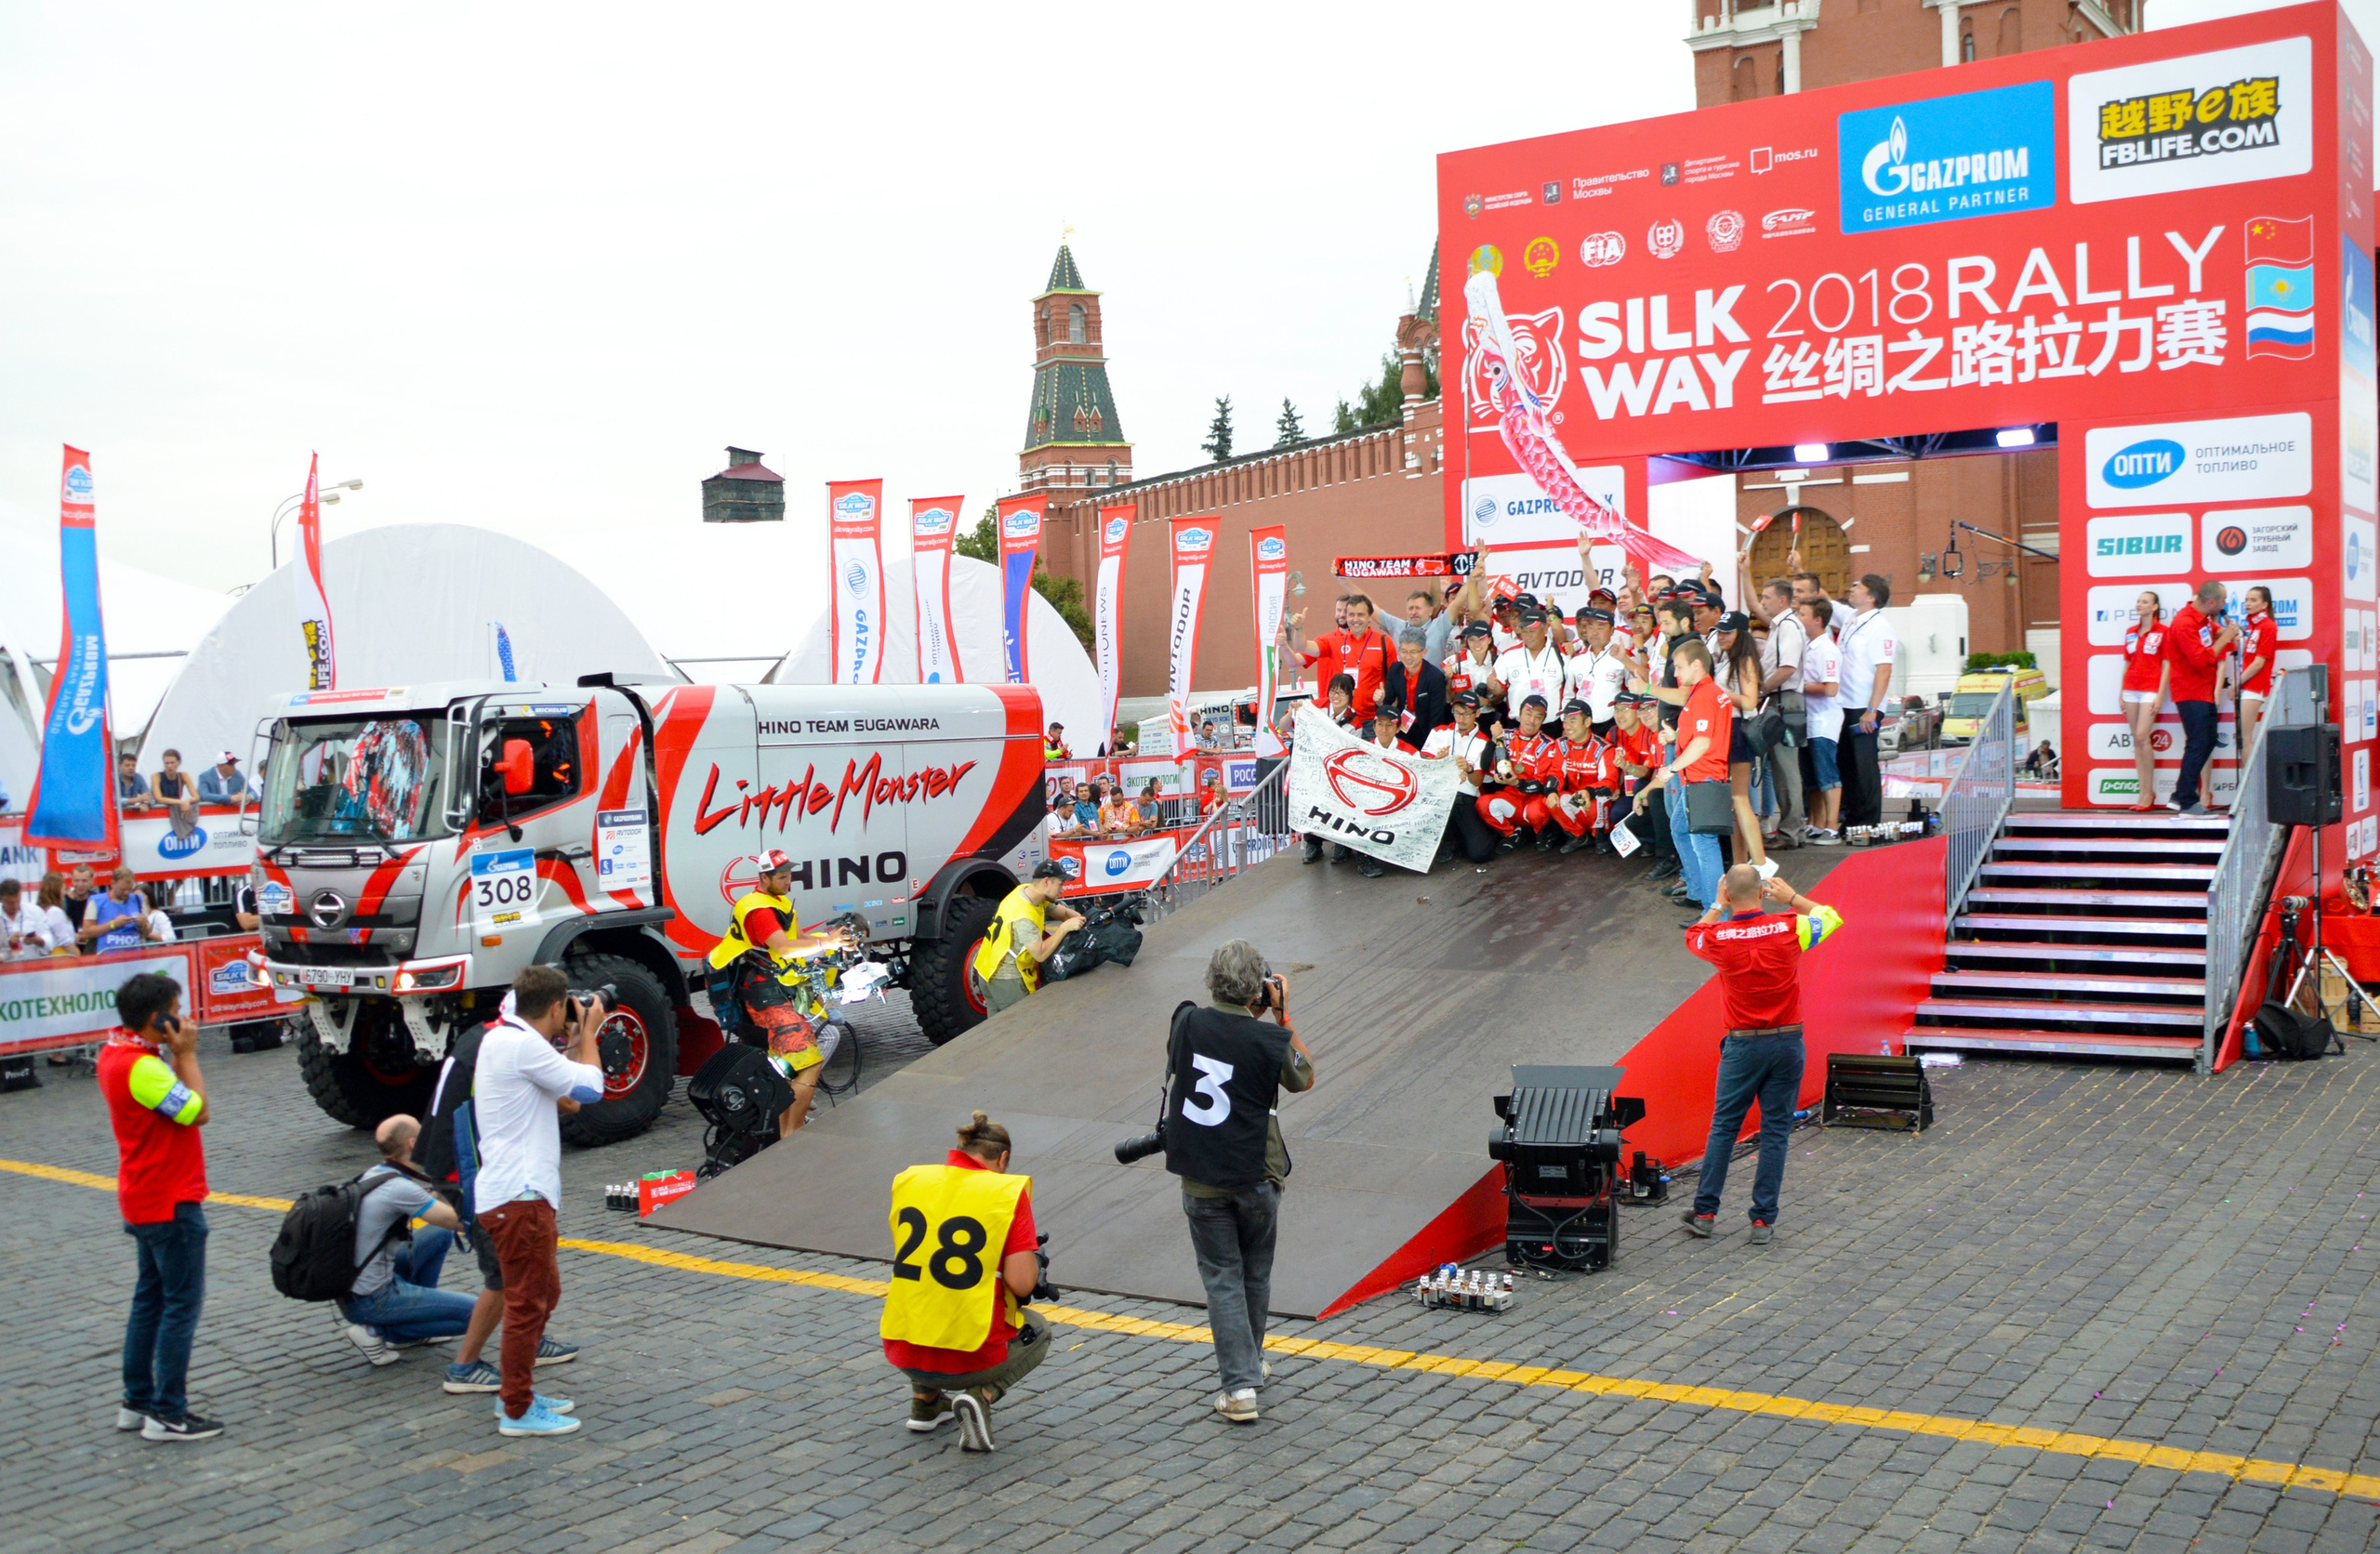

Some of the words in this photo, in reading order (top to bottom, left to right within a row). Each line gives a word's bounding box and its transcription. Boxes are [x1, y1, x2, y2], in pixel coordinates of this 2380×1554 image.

[2099, 77, 2278, 140] 越野e族
[2102, 121, 2277, 167] FBLIFE.COM
[1775, 149, 1818, 163] mos.ru
[1573, 168, 1650, 190] Правительство
[1911, 147, 2029, 193] GAZPROM
[1573, 187, 1612, 200] Москвы
[1863, 200, 1941, 223] GENERAL
[1949, 187, 2030, 211] PARTNER
[1579, 283, 1752, 360] SILK
[1766, 262, 1934, 339] 2018
[1948, 225, 2226, 320] RALLY
[1762, 298, 2228, 405] 丝绸之路拉力赛
[1580, 349, 1752, 420] WAY
[2195, 441, 2295, 459] ОПТИМАЛЬНОЕ
[2114, 453, 2172, 476] ОПТИ
[2196, 459, 2258, 474] ТОПЛИВО
[2096, 534, 2182, 556] SIBUR
[2252, 533, 2291, 544] ТРУБНЫЙ
[2252, 544, 2279, 553] ЗАВОД
[1344, 560, 1375, 570] HINO
[1380, 560, 1410, 569] TEAM
[1345, 568, 1410, 577] SUGAWARA
[1516, 568, 1614, 590] AVTODR
[1199, 705, 1230, 715] HINO
[759, 720, 801, 735] HINO
[806, 718, 850, 733] TEAM
[854, 718, 940, 732] SUGAWARA
[2152, 734, 2169, 748] 24
[830, 751, 978, 835] Monster
[1308, 805, 1395, 846] HINO
[214, 839, 247, 849] ТОПЛИВО
[789, 850, 906, 891] HINO
[1109, 856, 1128, 870] ОПТИ
[477, 875, 532, 907] 308
[1716, 921, 1790, 941] 丝绸之路拉力赛
[216, 972, 239, 981] SILK
[306, 969, 328, 983] 6790
[210, 999, 268, 1013] silkwayrally.com
[1183, 1052, 1235, 1127] 3
[892, 1205, 987, 1290] 28
